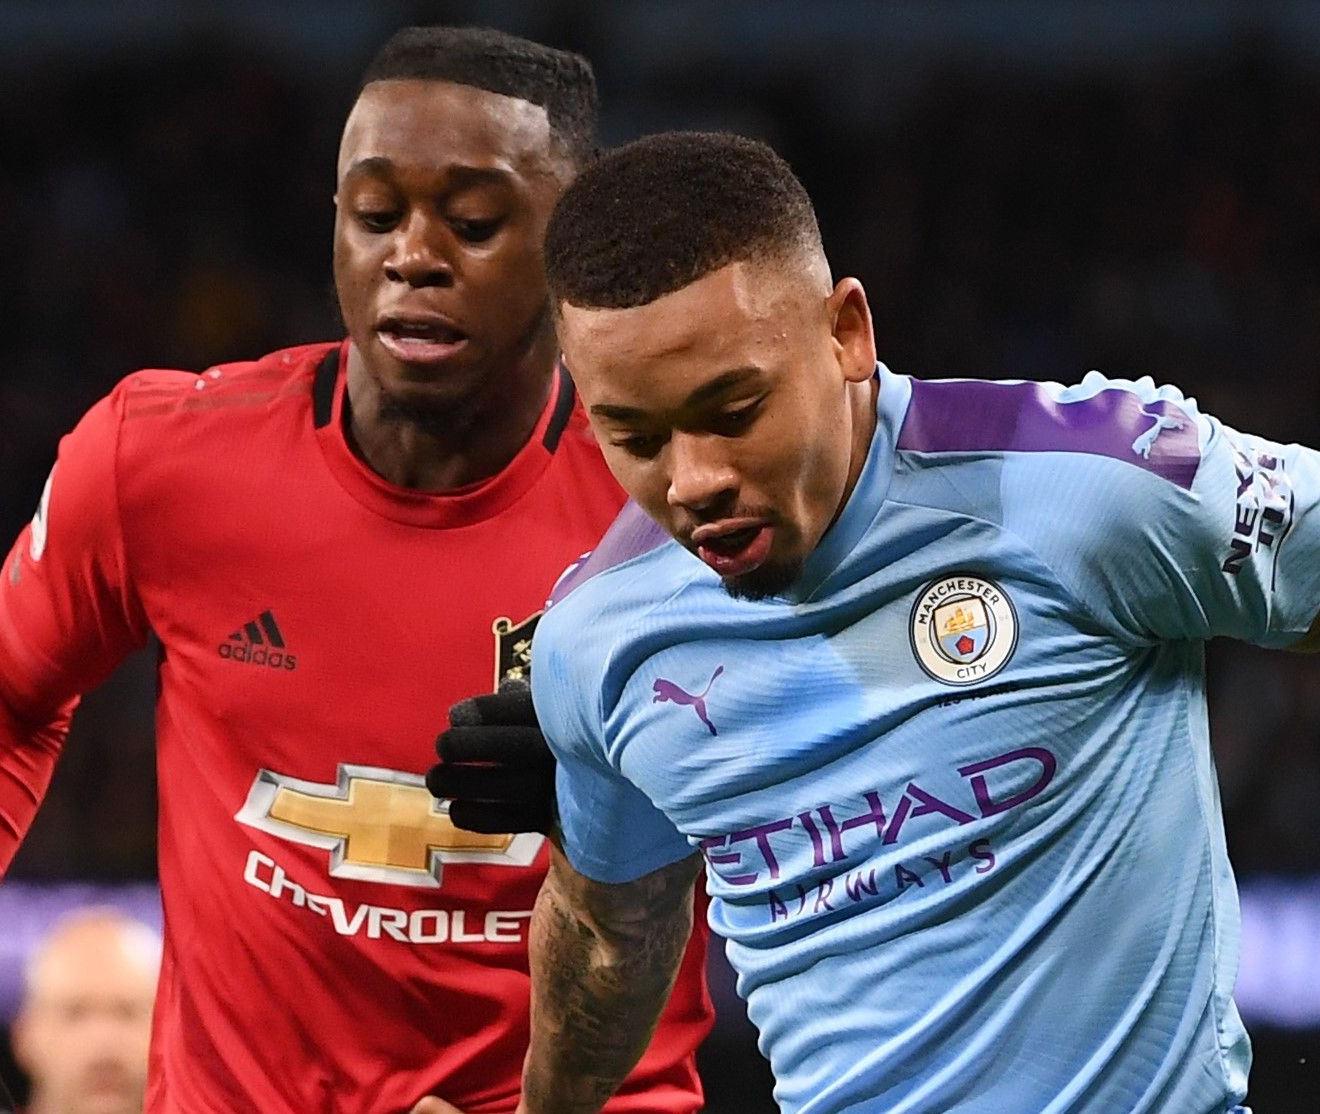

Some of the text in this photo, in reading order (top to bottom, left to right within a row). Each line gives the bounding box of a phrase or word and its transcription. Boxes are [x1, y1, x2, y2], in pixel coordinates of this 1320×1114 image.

[1221, 449, 1254, 575] NEX
[918, 579, 1000, 625] MANCHESTER
[217, 643, 296, 671] adidas
[956, 662, 988, 680] CITY
[699, 746, 1057, 886] ETIHAD
[768, 837, 996, 923] AIRWAYS
